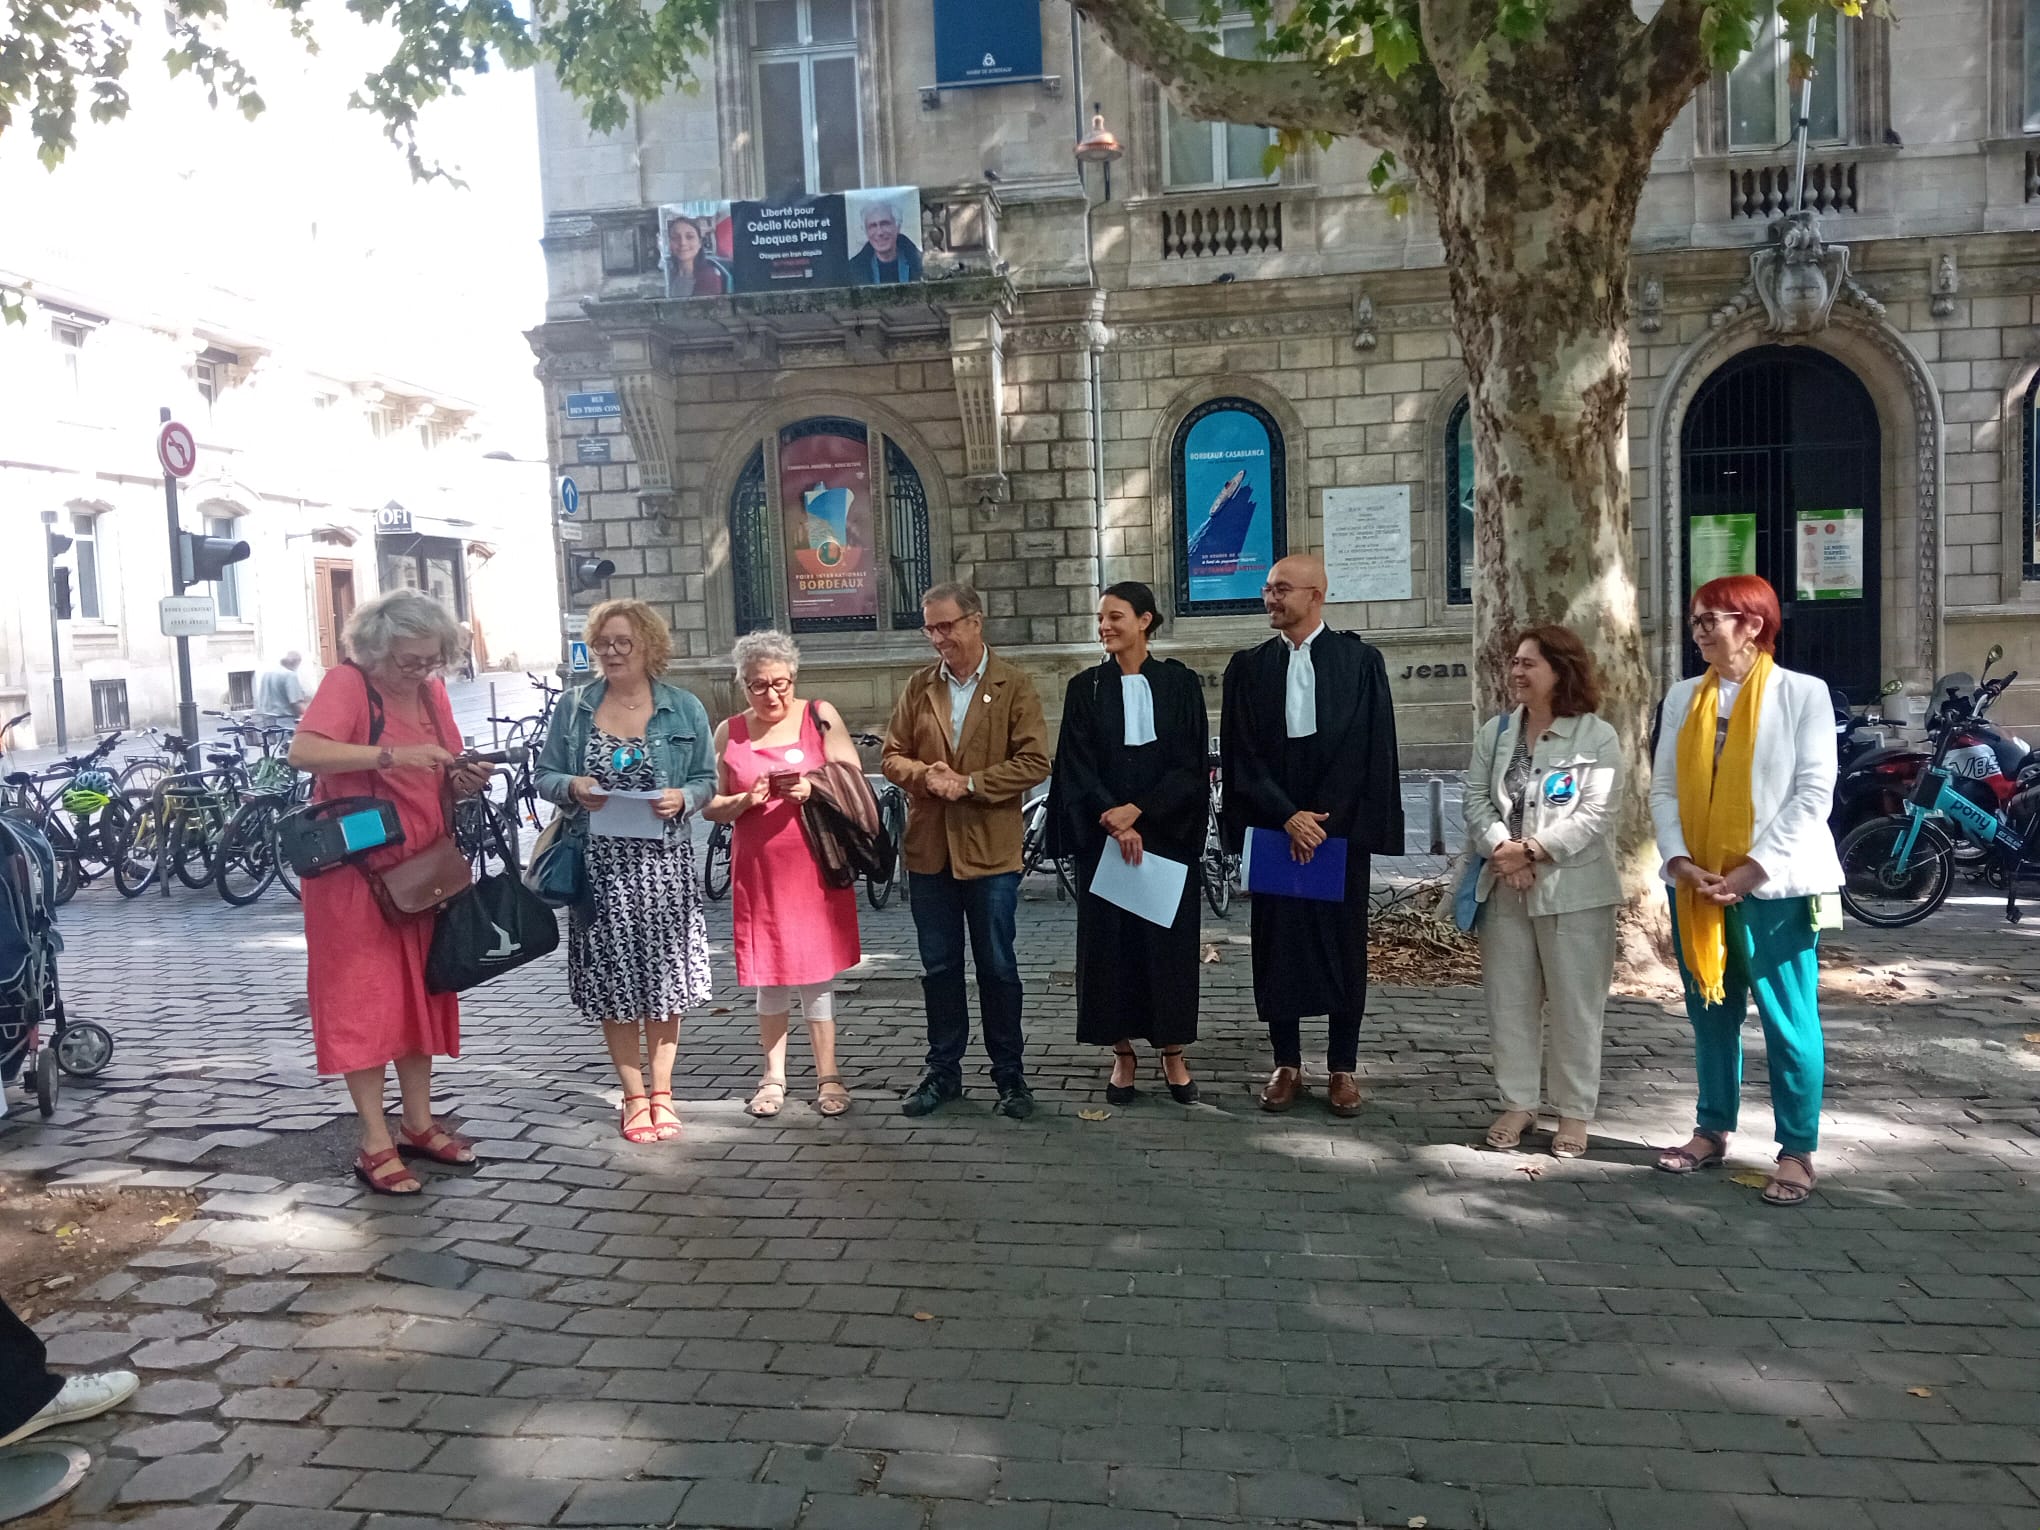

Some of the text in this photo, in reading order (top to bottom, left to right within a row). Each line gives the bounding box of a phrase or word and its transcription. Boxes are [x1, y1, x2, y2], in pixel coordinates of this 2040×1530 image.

[761, 206, 815, 218] Liberté pour
[747, 218, 831, 232] Cécile Kohler et
[751, 230, 828, 246] Jacques Paris
[800, 578, 865, 591] BORDEAUX
[1950, 799, 1992, 831] pony
